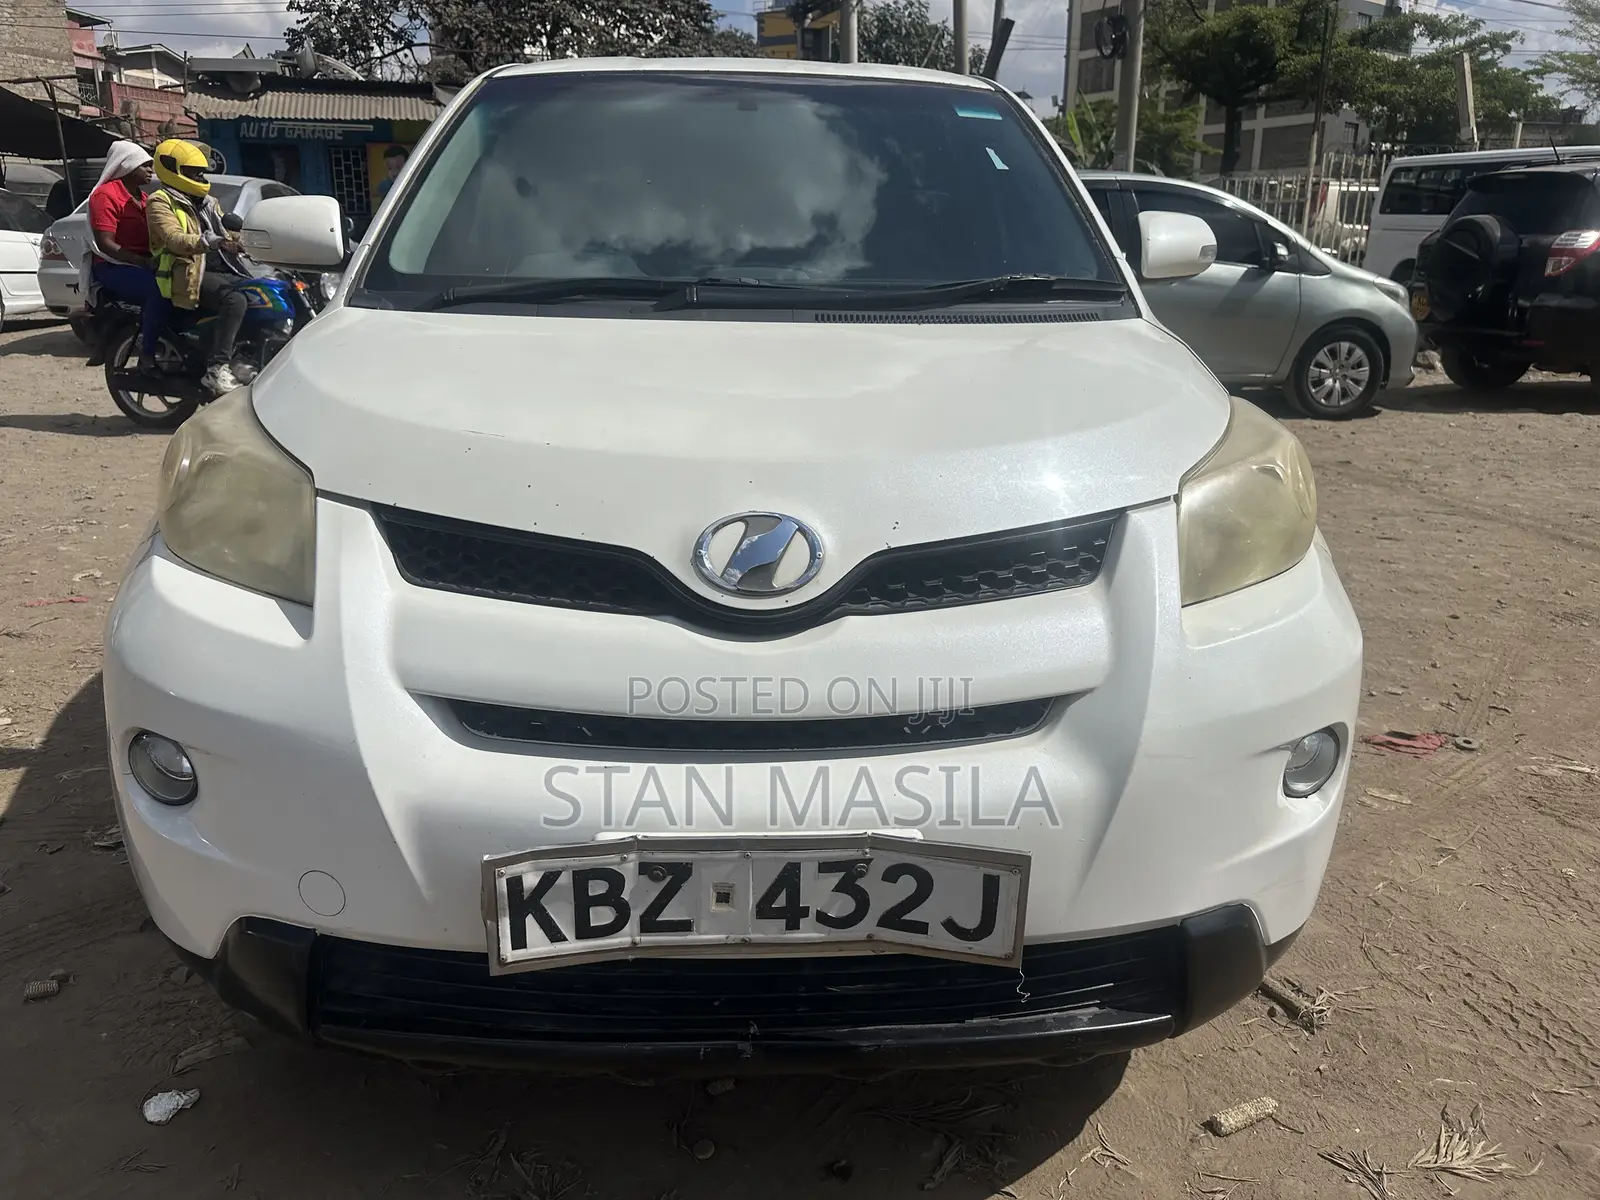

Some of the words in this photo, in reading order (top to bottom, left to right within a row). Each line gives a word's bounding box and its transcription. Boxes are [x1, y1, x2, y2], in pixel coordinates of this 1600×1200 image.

[240, 121, 278, 138] AUTO
[285, 127, 343, 140] GARAGE
[506, 861, 694, 950] KBZ
[755, 858, 1000, 942] 432J
